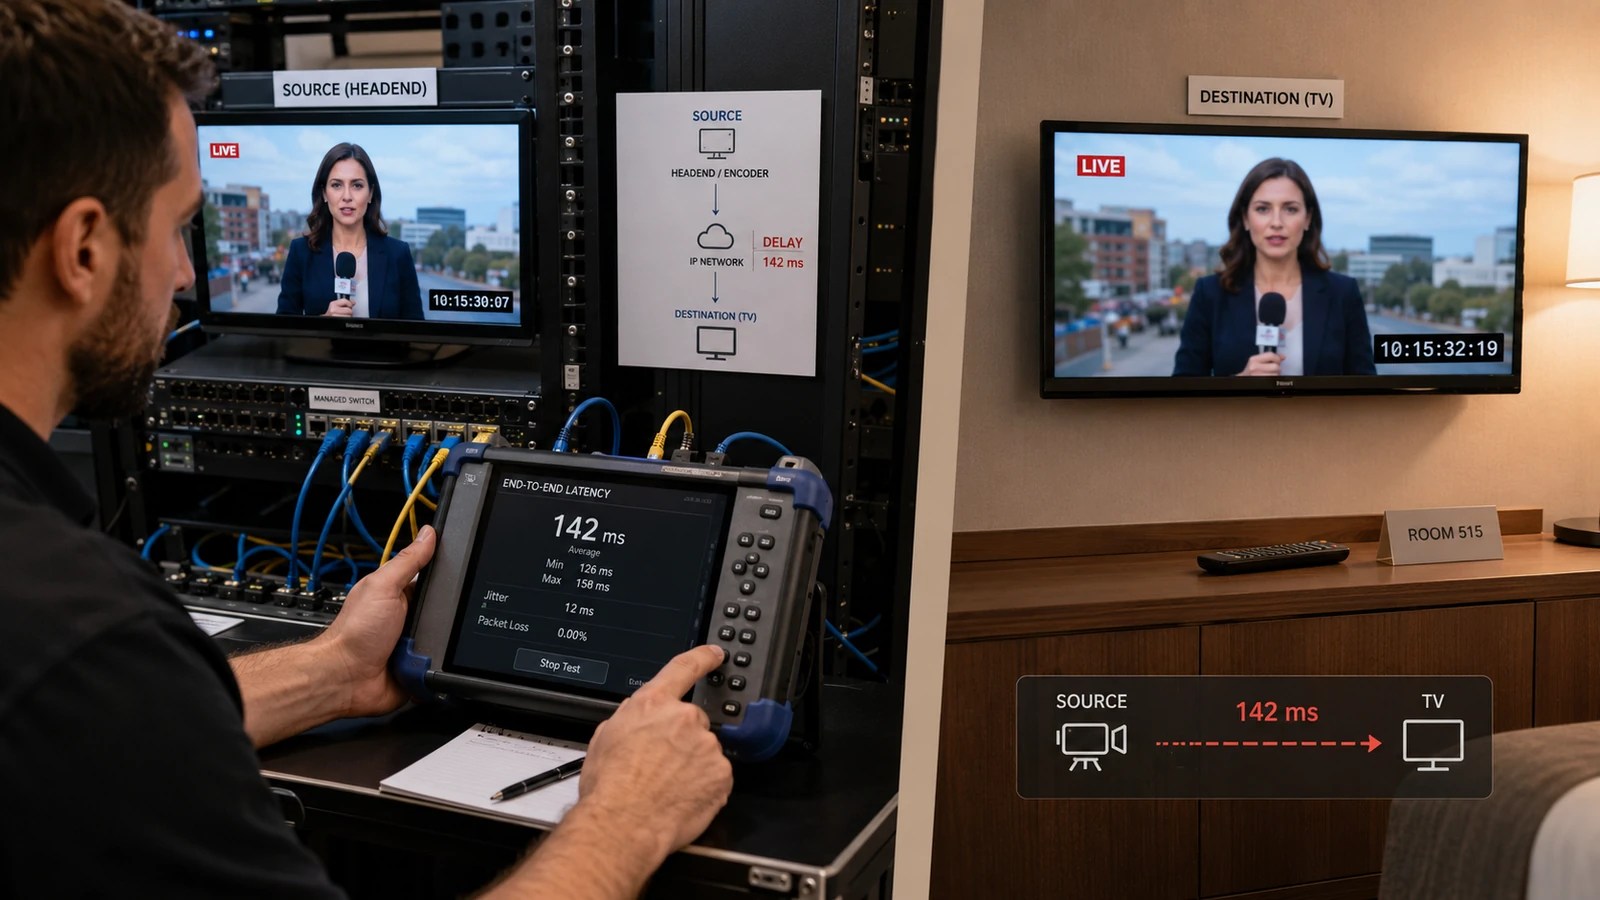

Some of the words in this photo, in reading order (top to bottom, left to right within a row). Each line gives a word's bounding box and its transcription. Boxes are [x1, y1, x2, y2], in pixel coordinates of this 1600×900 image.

[282, 82, 341, 97] SOURCE
[344, 80, 428, 98] (HEADEND)
[1200, 90, 1300, 105] DESTINATION
[1304, 92, 1334, 107] (TV)
[693, 110, 742, 121] SOURCE
[213, 145, 236, 156] LIVE
[671, 168, 716, 178] HEADEND
[724, 168, 769, 178] ENCODER
[1082, 159, 1120, 173] LIVE
[763, 236, 803, 248] DELAY
[689, 257, 698, 266] IP
[700, 258, 744, 267] NETWORK
[763, 257, 784, 268] 142
[787, 259, 804, 268] ms
[432, 294, 510, 309] 10:15:30:07
[674, 310, 736, 321] DESTINATION
[738, 312, 757, 323] (TV)
[1380, 340, 1499, 358] 10:15:32:19
[314, 395, 347, 403] MANAGED
[348, 397, 375, 405] SWITCH
[502, 478, 563, 493] END-TO-END
[565, 485, 611, 499] LATENCY
[554, 514, 599, 542] 142
[602, 531, 626, 545] ms
[1408, 526, 1454, 541] ROOM
[1458, 525, 1483, 539] 515
[567, 545, 601, 559] Average
[545, 558, 564, 570] Min
[579, 563, 597, 575] 126
[598, 567, 613, 577] ms
[541, 573, 562, 585] Max
[576, 578, 594, 589] 158
[595, 583, 610, 592] ms
[483, 590, 509, 602] Jitter
[565, 602, 577, 613] 12
[579, 606, 594, 616] ms
[477, 615, 507, 629] Packet
[509, 620, 530, 632] Loss
[557, 627, 588, 642] 0.00%
[539, 657, 561, 672] Stop
[562, 662, 581, 674] Test
